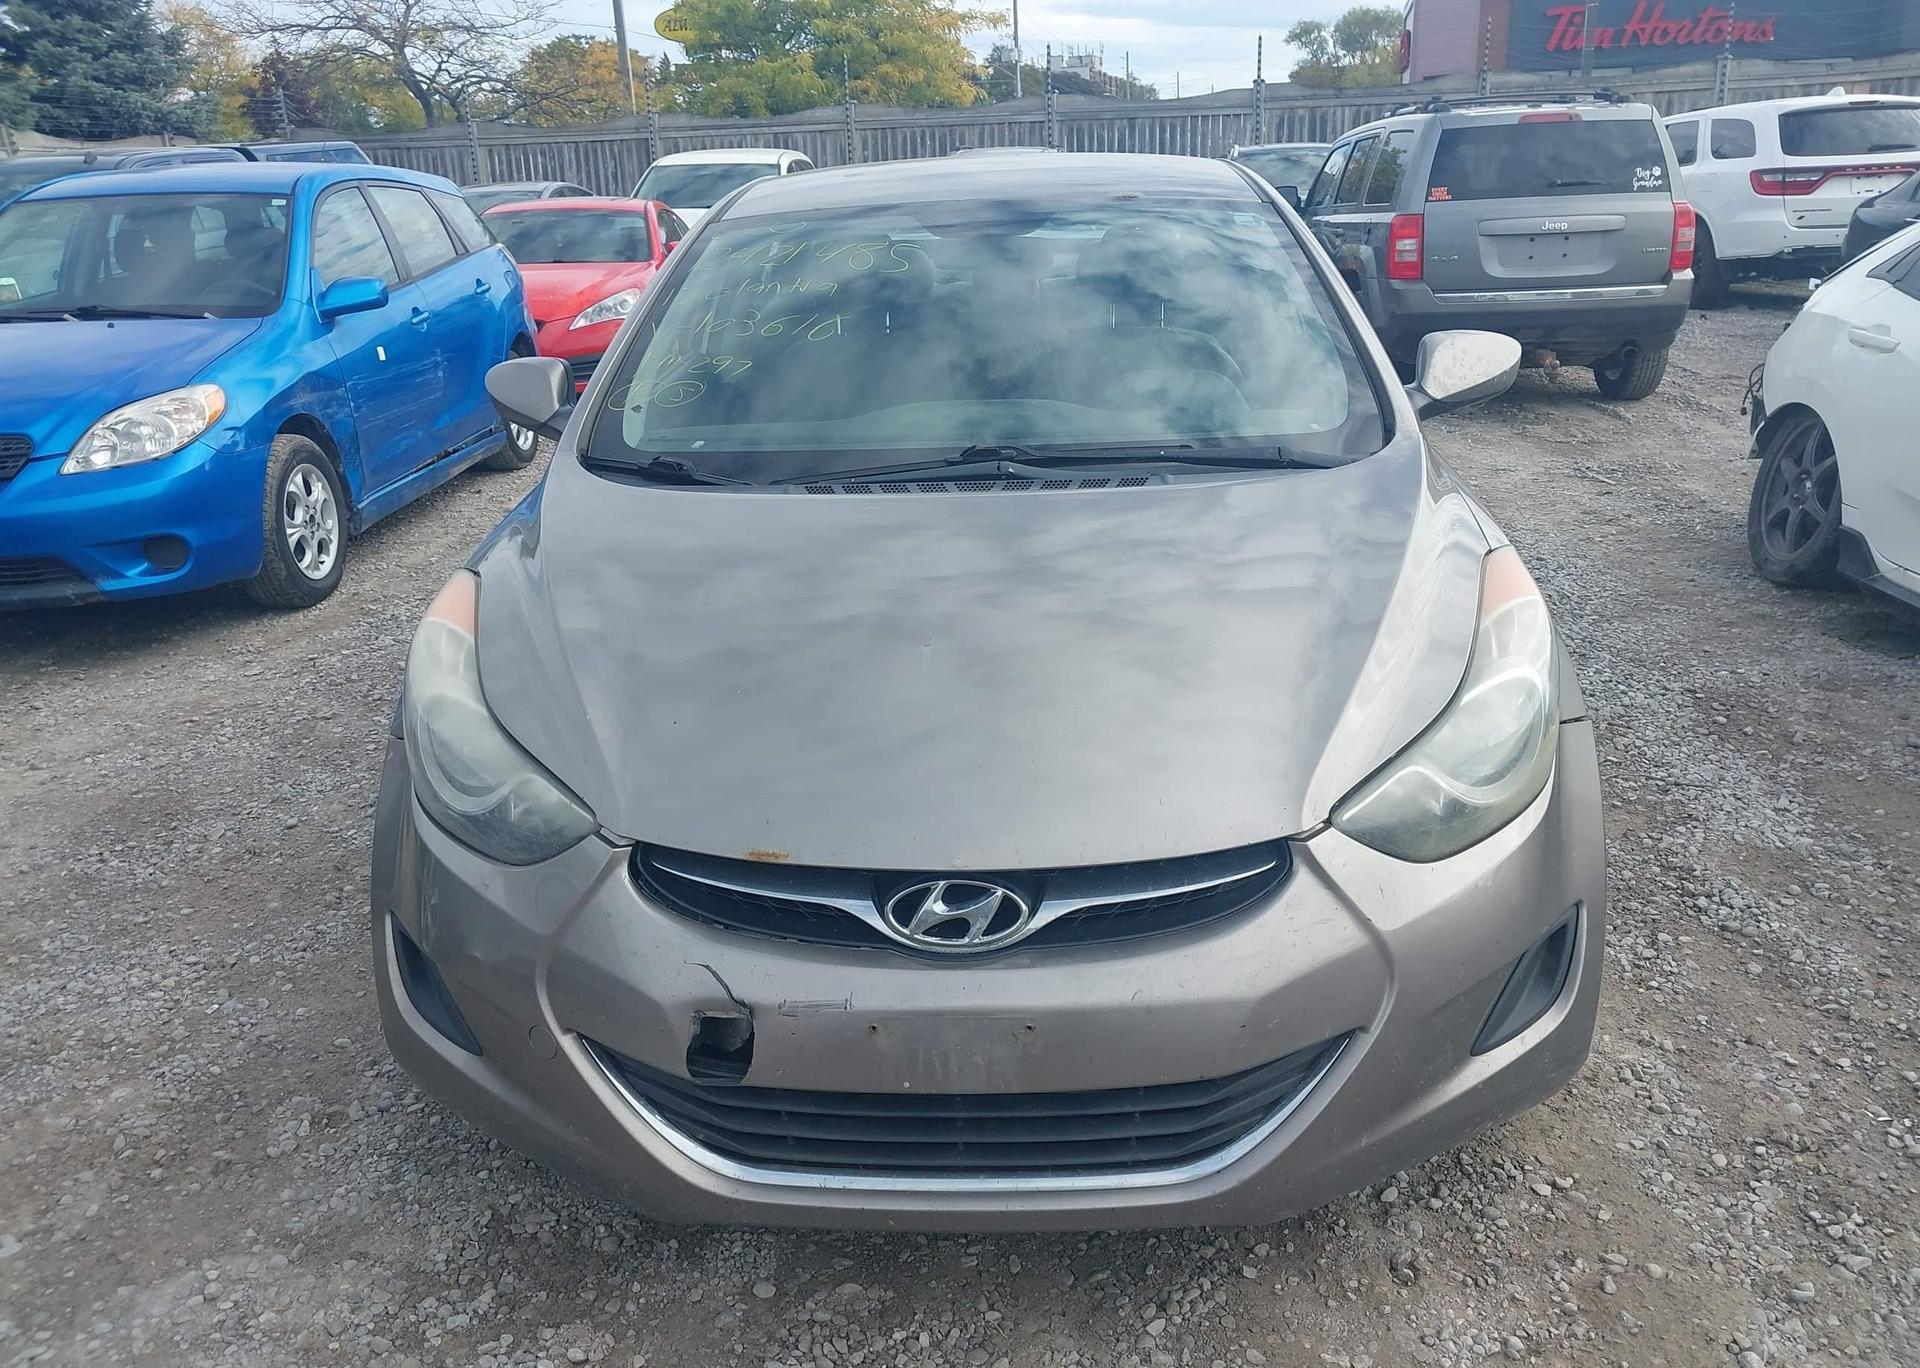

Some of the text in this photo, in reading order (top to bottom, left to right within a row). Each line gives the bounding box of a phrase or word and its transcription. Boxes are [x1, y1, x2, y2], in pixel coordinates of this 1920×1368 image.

[1620, 0, 1777, 48] Hortons
[1634, 167, 1650, 181] Dog
[1541, 220, 1568, 231] Jeep
